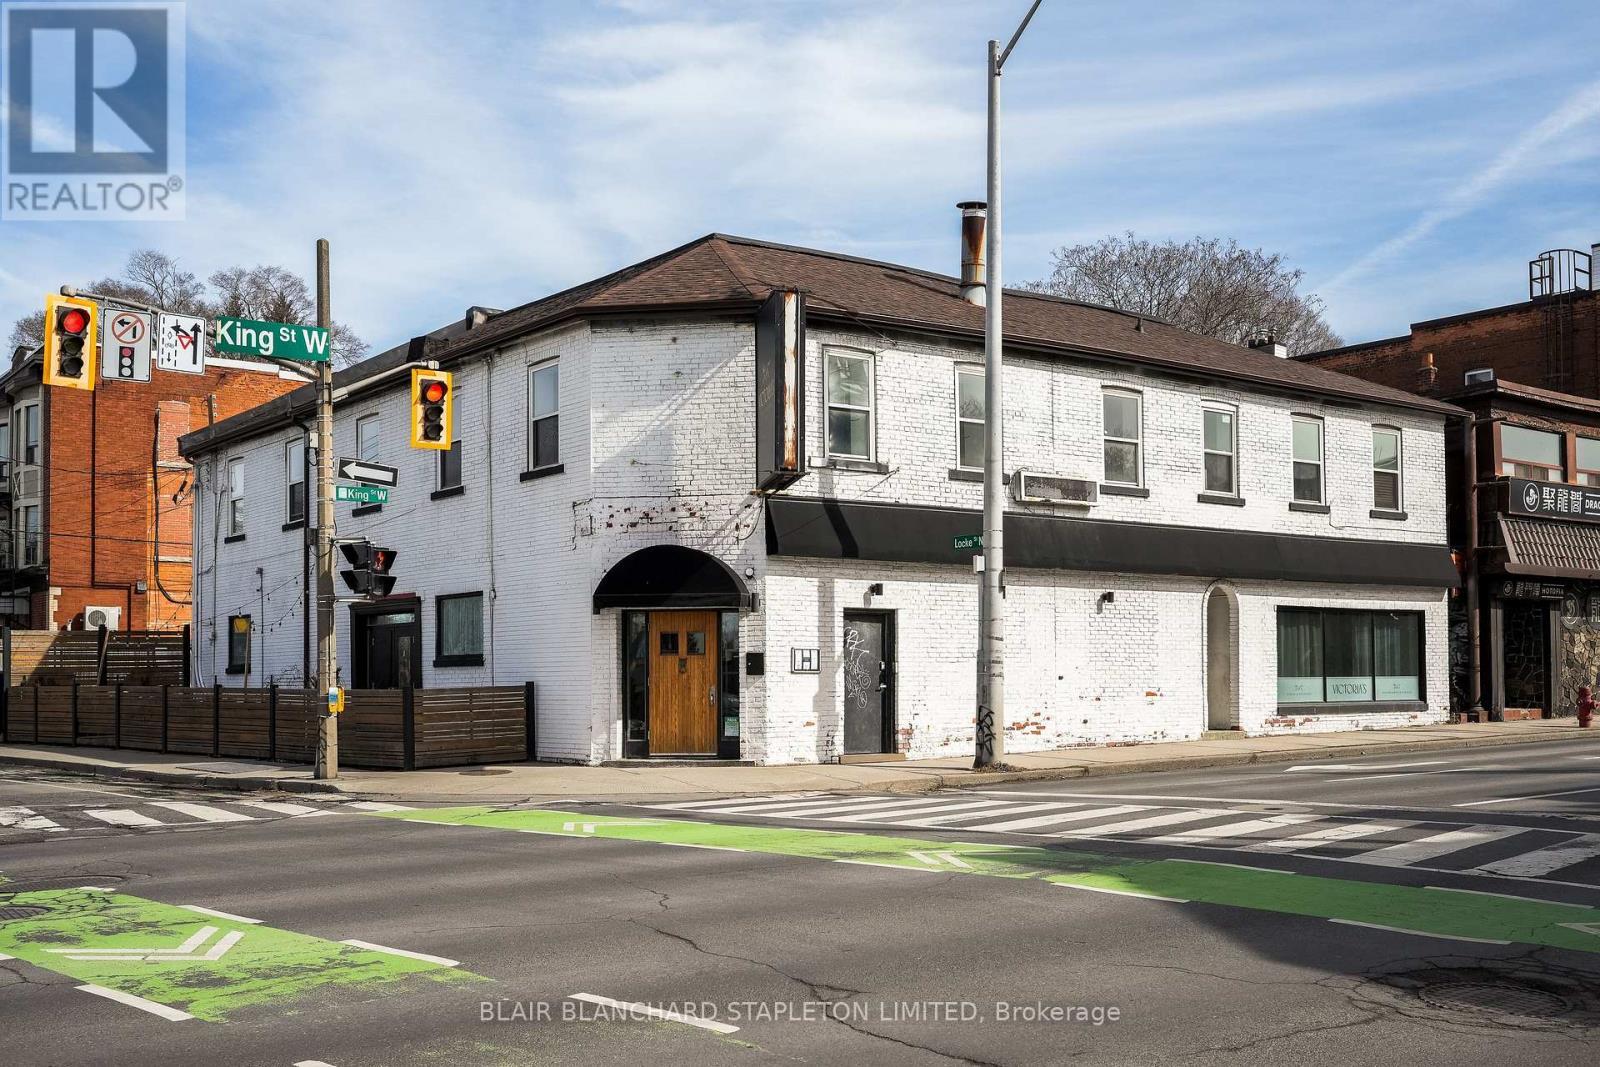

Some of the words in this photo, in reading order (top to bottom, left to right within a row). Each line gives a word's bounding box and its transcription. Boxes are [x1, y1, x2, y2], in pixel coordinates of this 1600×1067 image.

[216, 320, 273, 355] King
[279, 327, 296, 342] St
[302, 329, 328, 354] W
[348, 488, 369, 502] King
[377, 490, 387, 501] W
[954, 537, 973, 549] Locke
